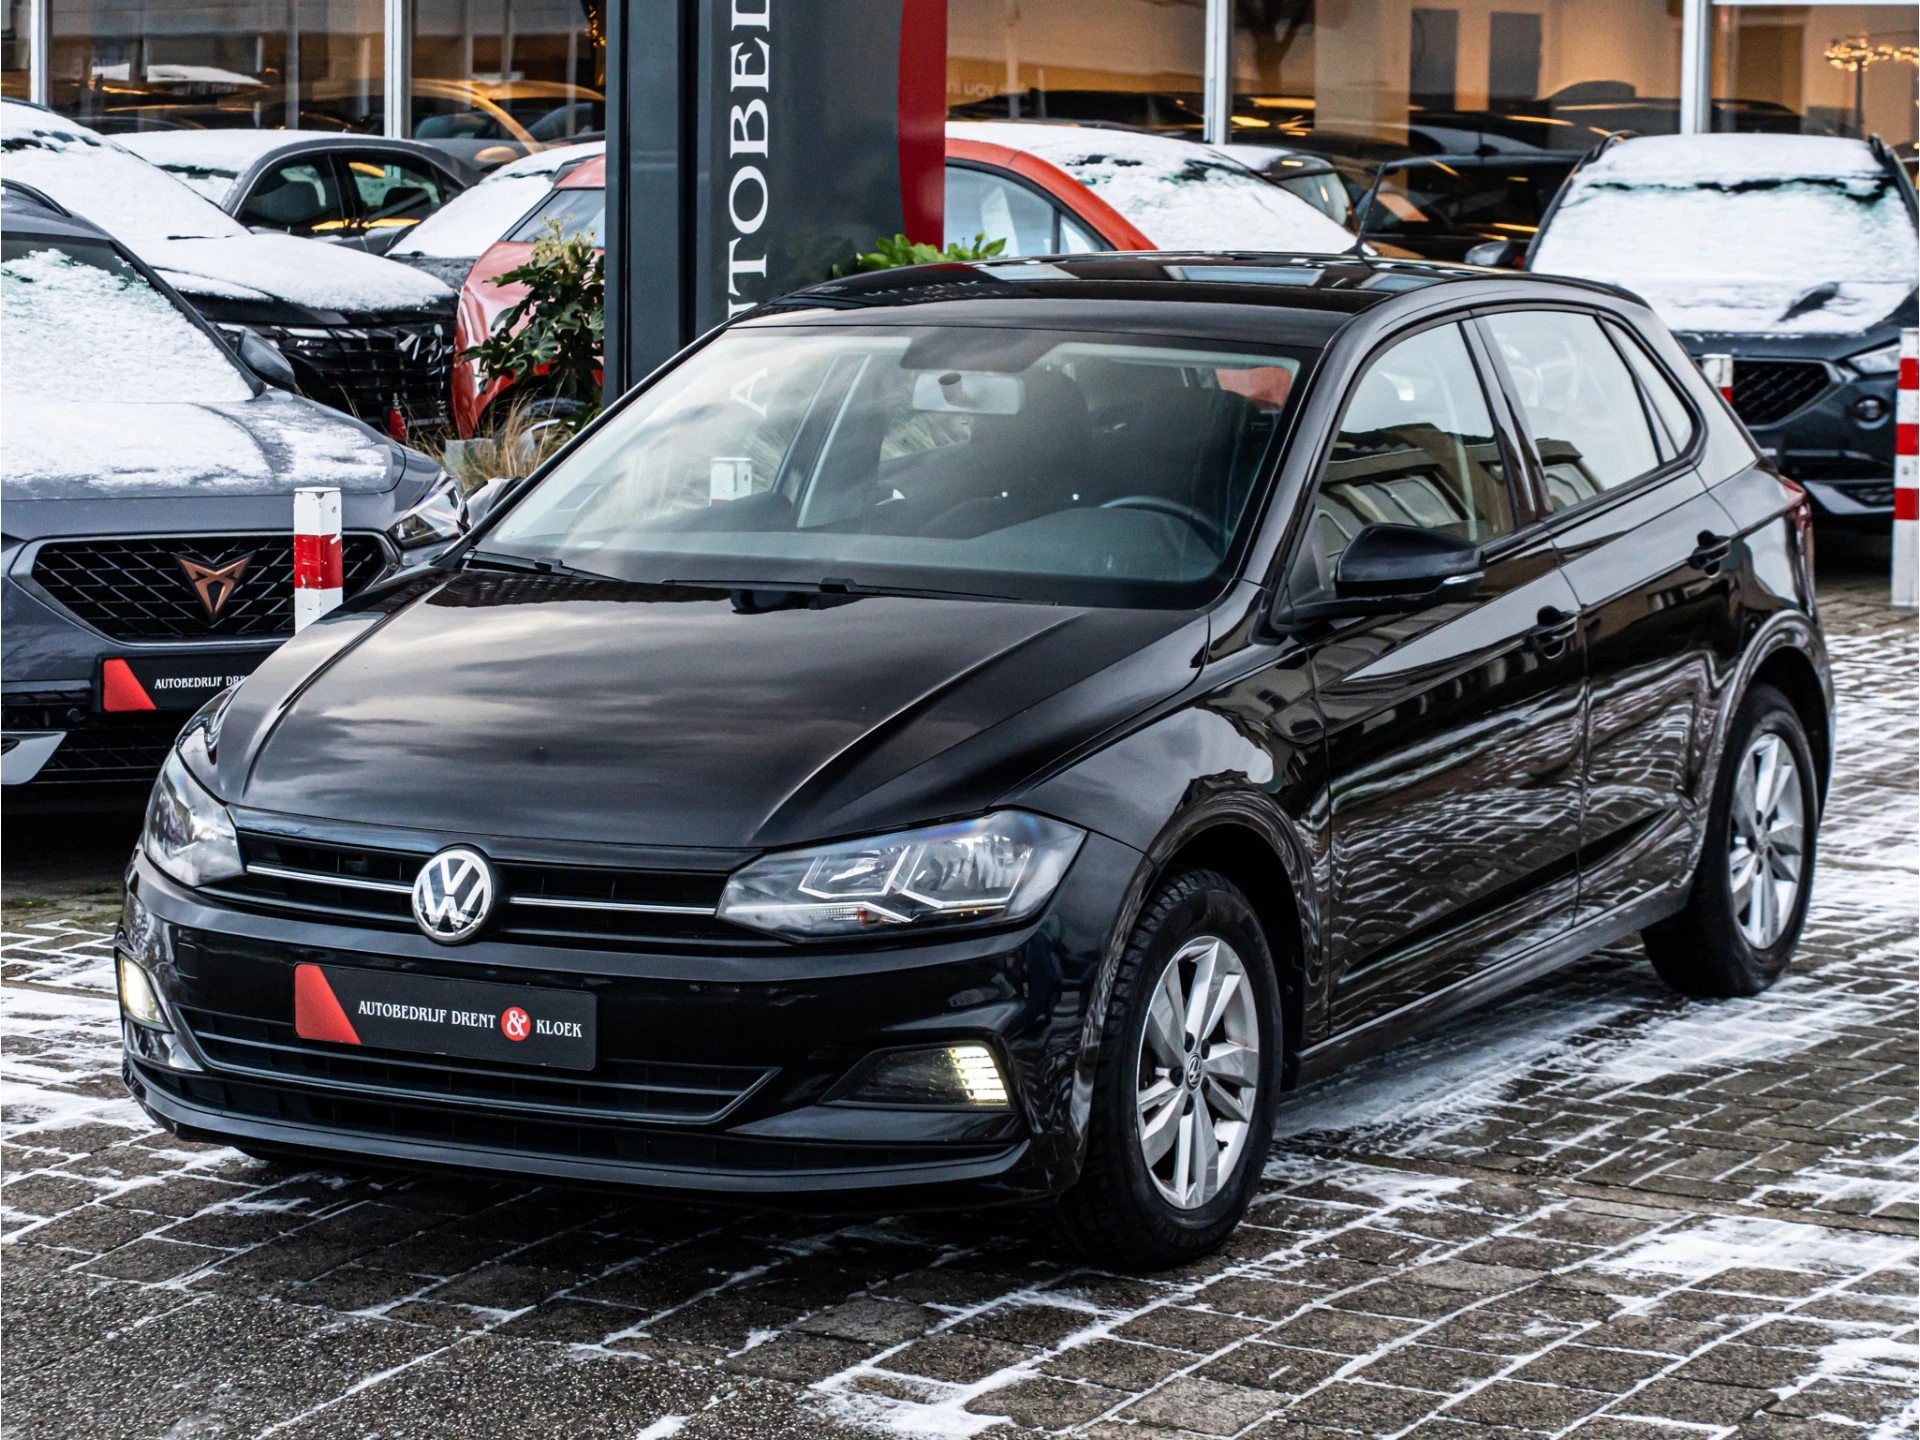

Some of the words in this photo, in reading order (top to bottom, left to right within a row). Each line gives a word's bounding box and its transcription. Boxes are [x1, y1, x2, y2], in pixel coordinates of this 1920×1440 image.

[154, 676, 223, 690] AUTOBEDRIJF
[358, 1000, 448, 1024] AUTOBEDRIJF
[451, 1010, 496, 1029] DRENT
[505, 1010, 527, 1036] &
[536, 1019, 583, 1038] KLOEK
